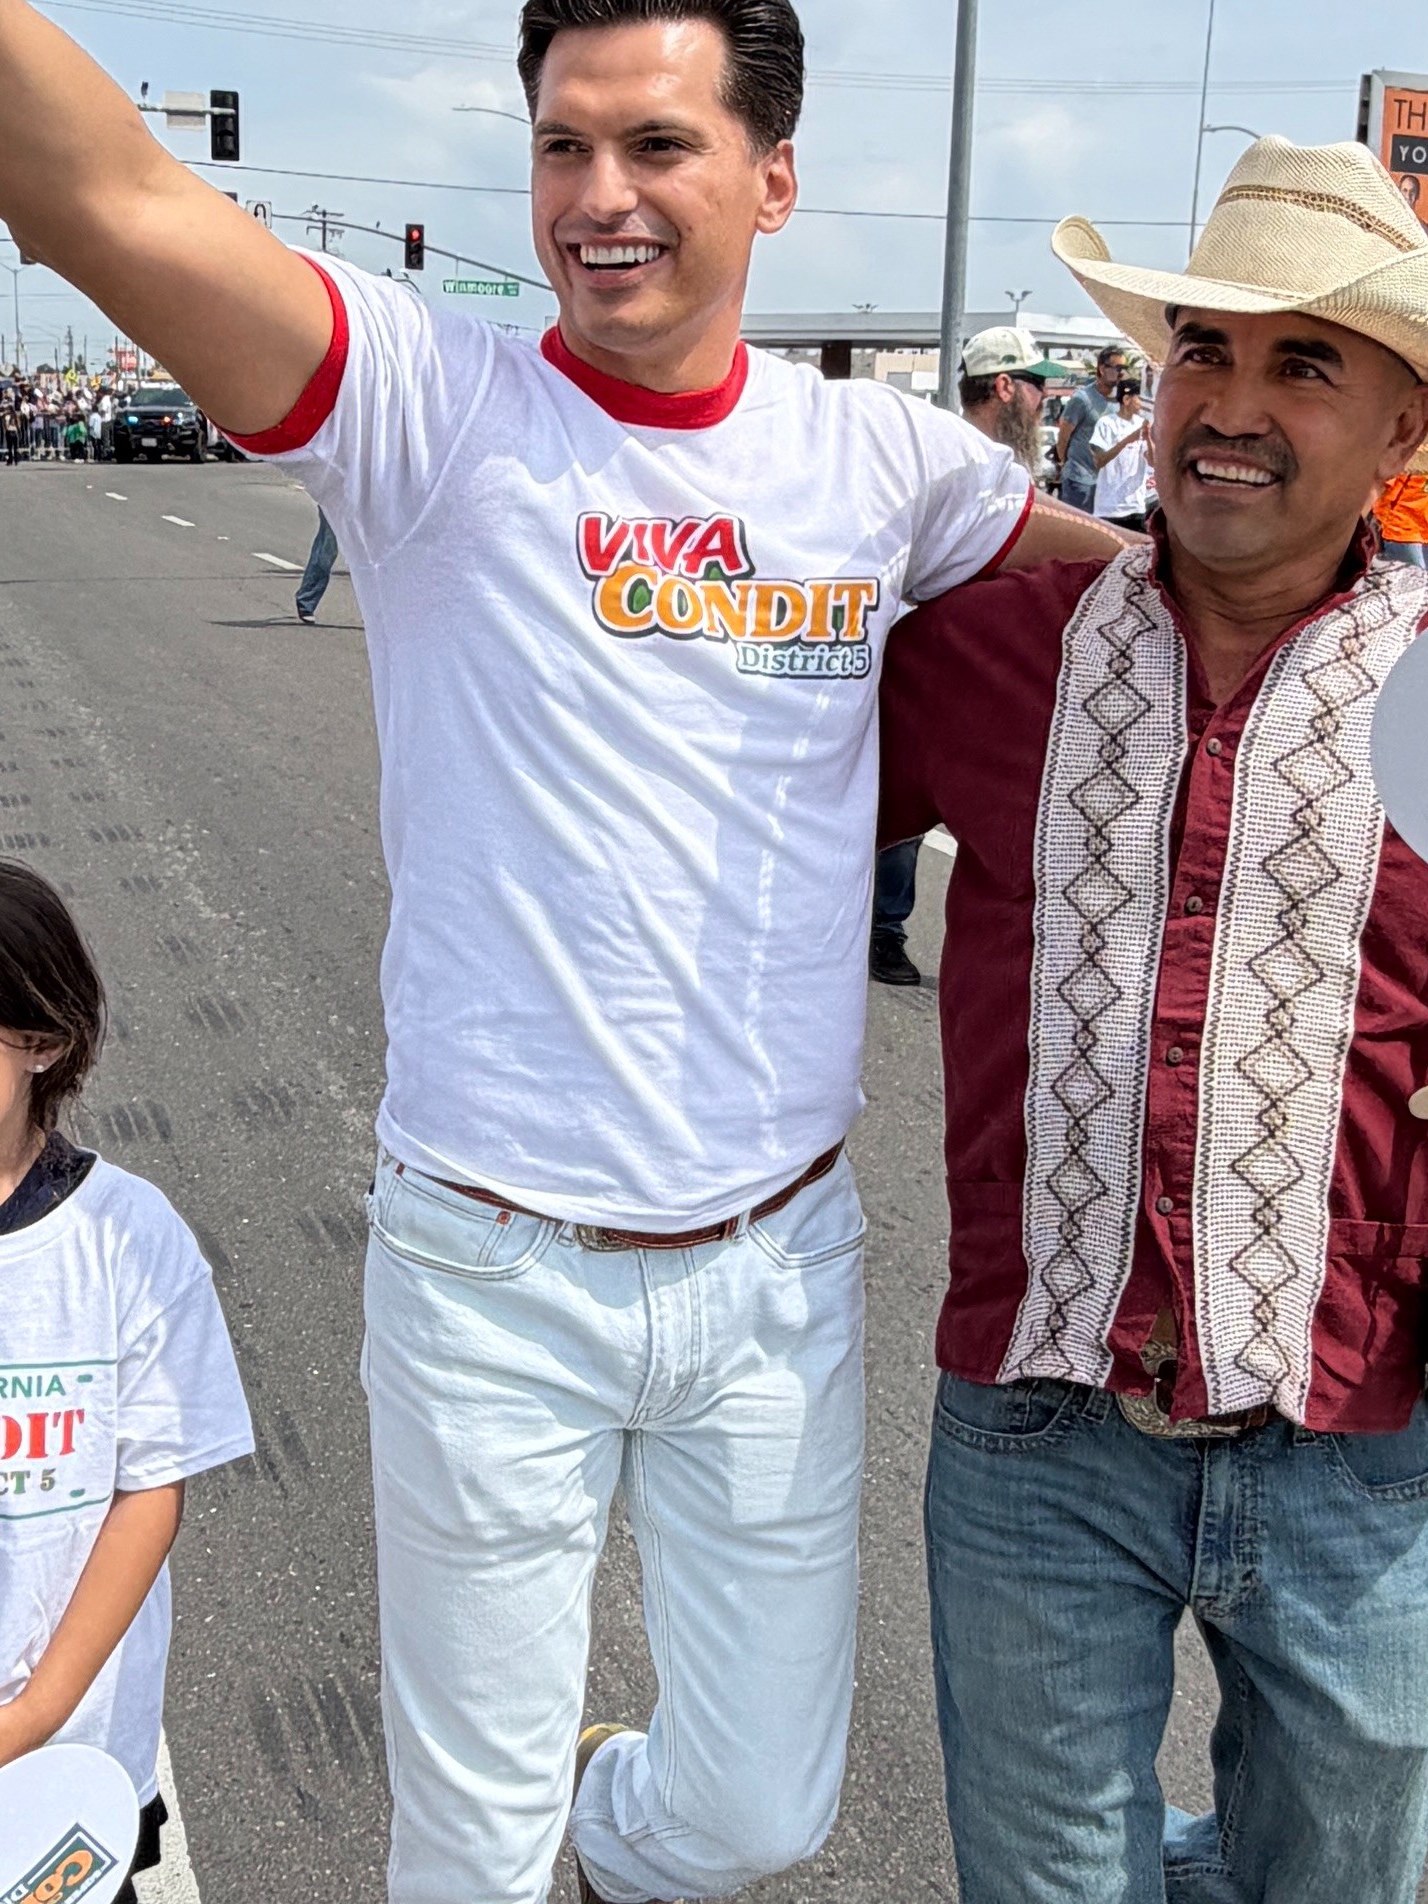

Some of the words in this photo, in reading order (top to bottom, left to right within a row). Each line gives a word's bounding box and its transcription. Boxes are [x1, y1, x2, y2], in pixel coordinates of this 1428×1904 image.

[579, 513, 754, 580] VIVA
[593, 564, 879, 643] CONDIT
[738, 642, 852, 676] District
[853, 644, 870, 675] 5
[40, 1467, 57, 1492] 5
